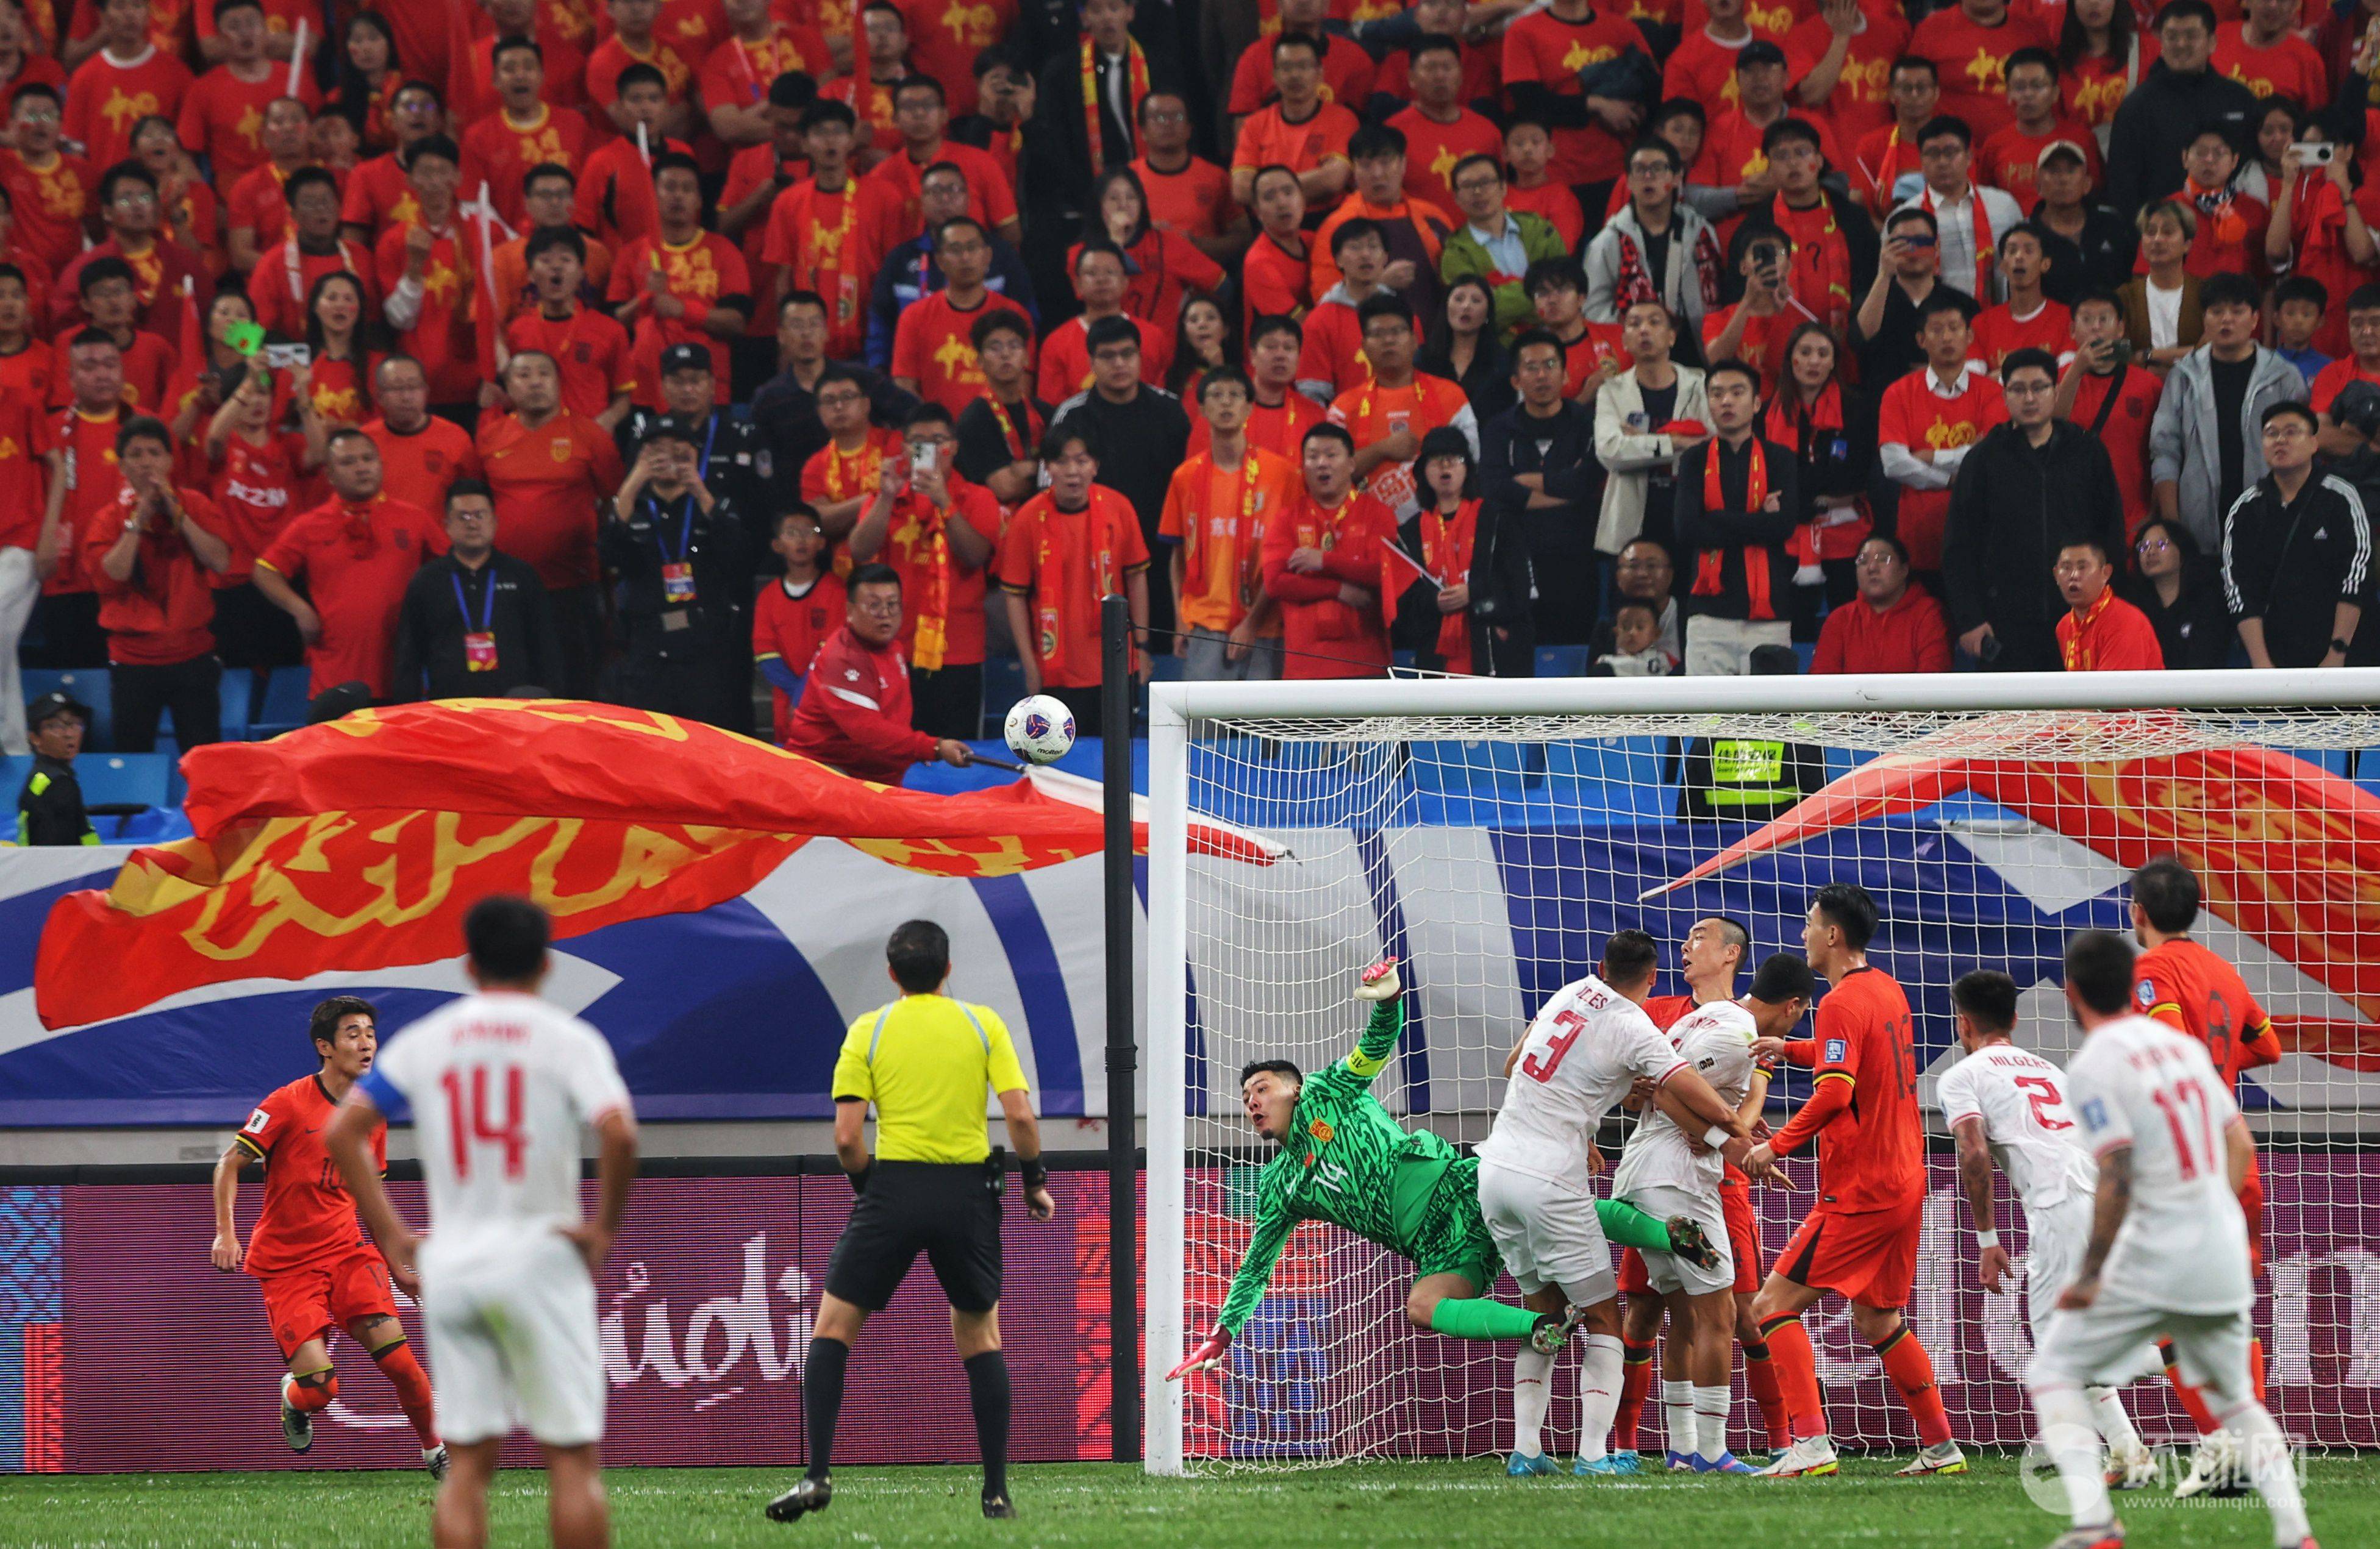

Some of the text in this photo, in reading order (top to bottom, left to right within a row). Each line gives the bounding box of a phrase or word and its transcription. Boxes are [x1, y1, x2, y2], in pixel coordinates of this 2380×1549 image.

[1523, 1010, 1589, 1083] 3
[1885, 1014, 1918, 1099] 16
[441, 1065, 531, 1180] 14
[2014, 1075, 2076, 1131] 2
[2153, 1077, 2216, 1181] 17
[1313, 1159, 1349, 1193] 14
